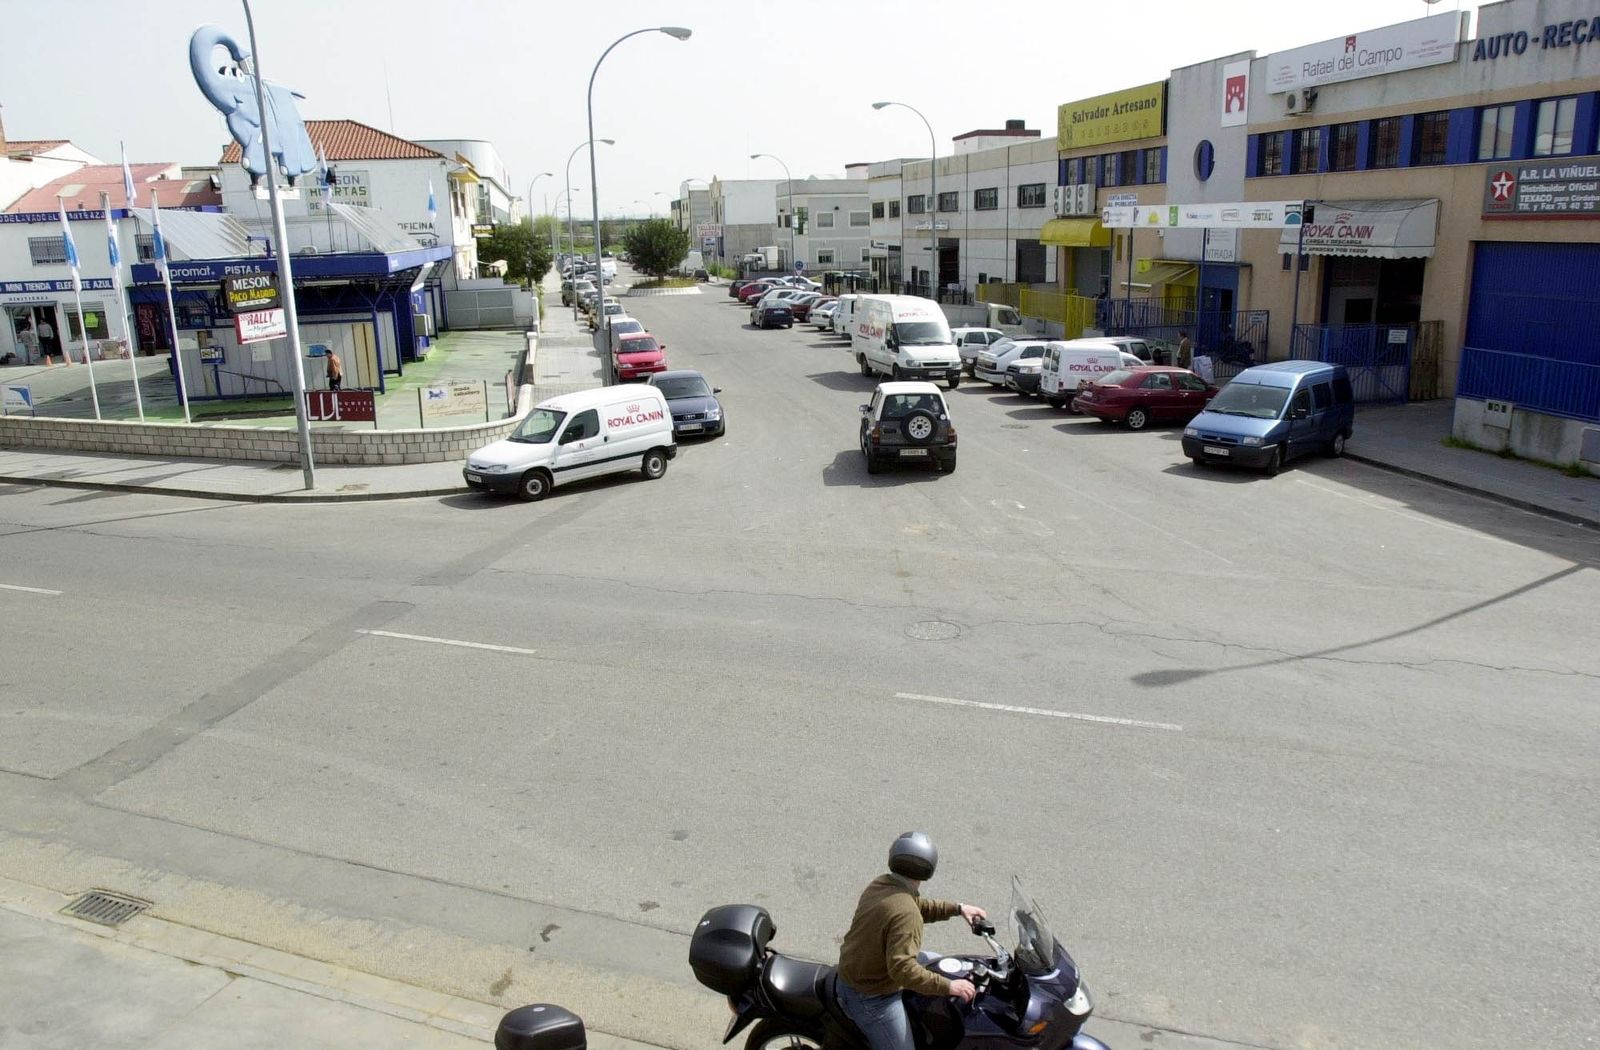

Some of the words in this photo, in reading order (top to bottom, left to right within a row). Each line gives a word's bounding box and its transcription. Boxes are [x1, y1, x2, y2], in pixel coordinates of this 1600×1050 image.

[1303, 58, 1335, 78] Rafael
[1338, 53, 1355, 71] del
[1358, 47, 1403, 68] Campo
[1072, 107, 1110, 124] Salvador
[1112, 97, 1157, 116] Artesano
[1543, 169, 1556, 179] LA
[1569, 183, 1597, 191] Oficial
[1519, 194, 1553, 203] TEXACO
[1302, 225, 1335, 238] ROYAL
[1338, 225, 1375, 240] CANIN
[224, 266, 253, 275] PISTA
[254, 266, 261, 274] 5
[5, 283, 23, 292] MINI
[24, 281, 51, 291] TIENDA
[92, 279, 112, 289] AZUL
[232, 276, 270, 291] MESON
[229, 291, 248, 303] PACO
[249, 288, 276, 300] MADRID
[247, 312, 274, 325] RALLY
[1069, 364, 1092, 372] ROYAL
[607, 415, 635, 429] ROYAL
[636, 409, 664, 423] CANIN
